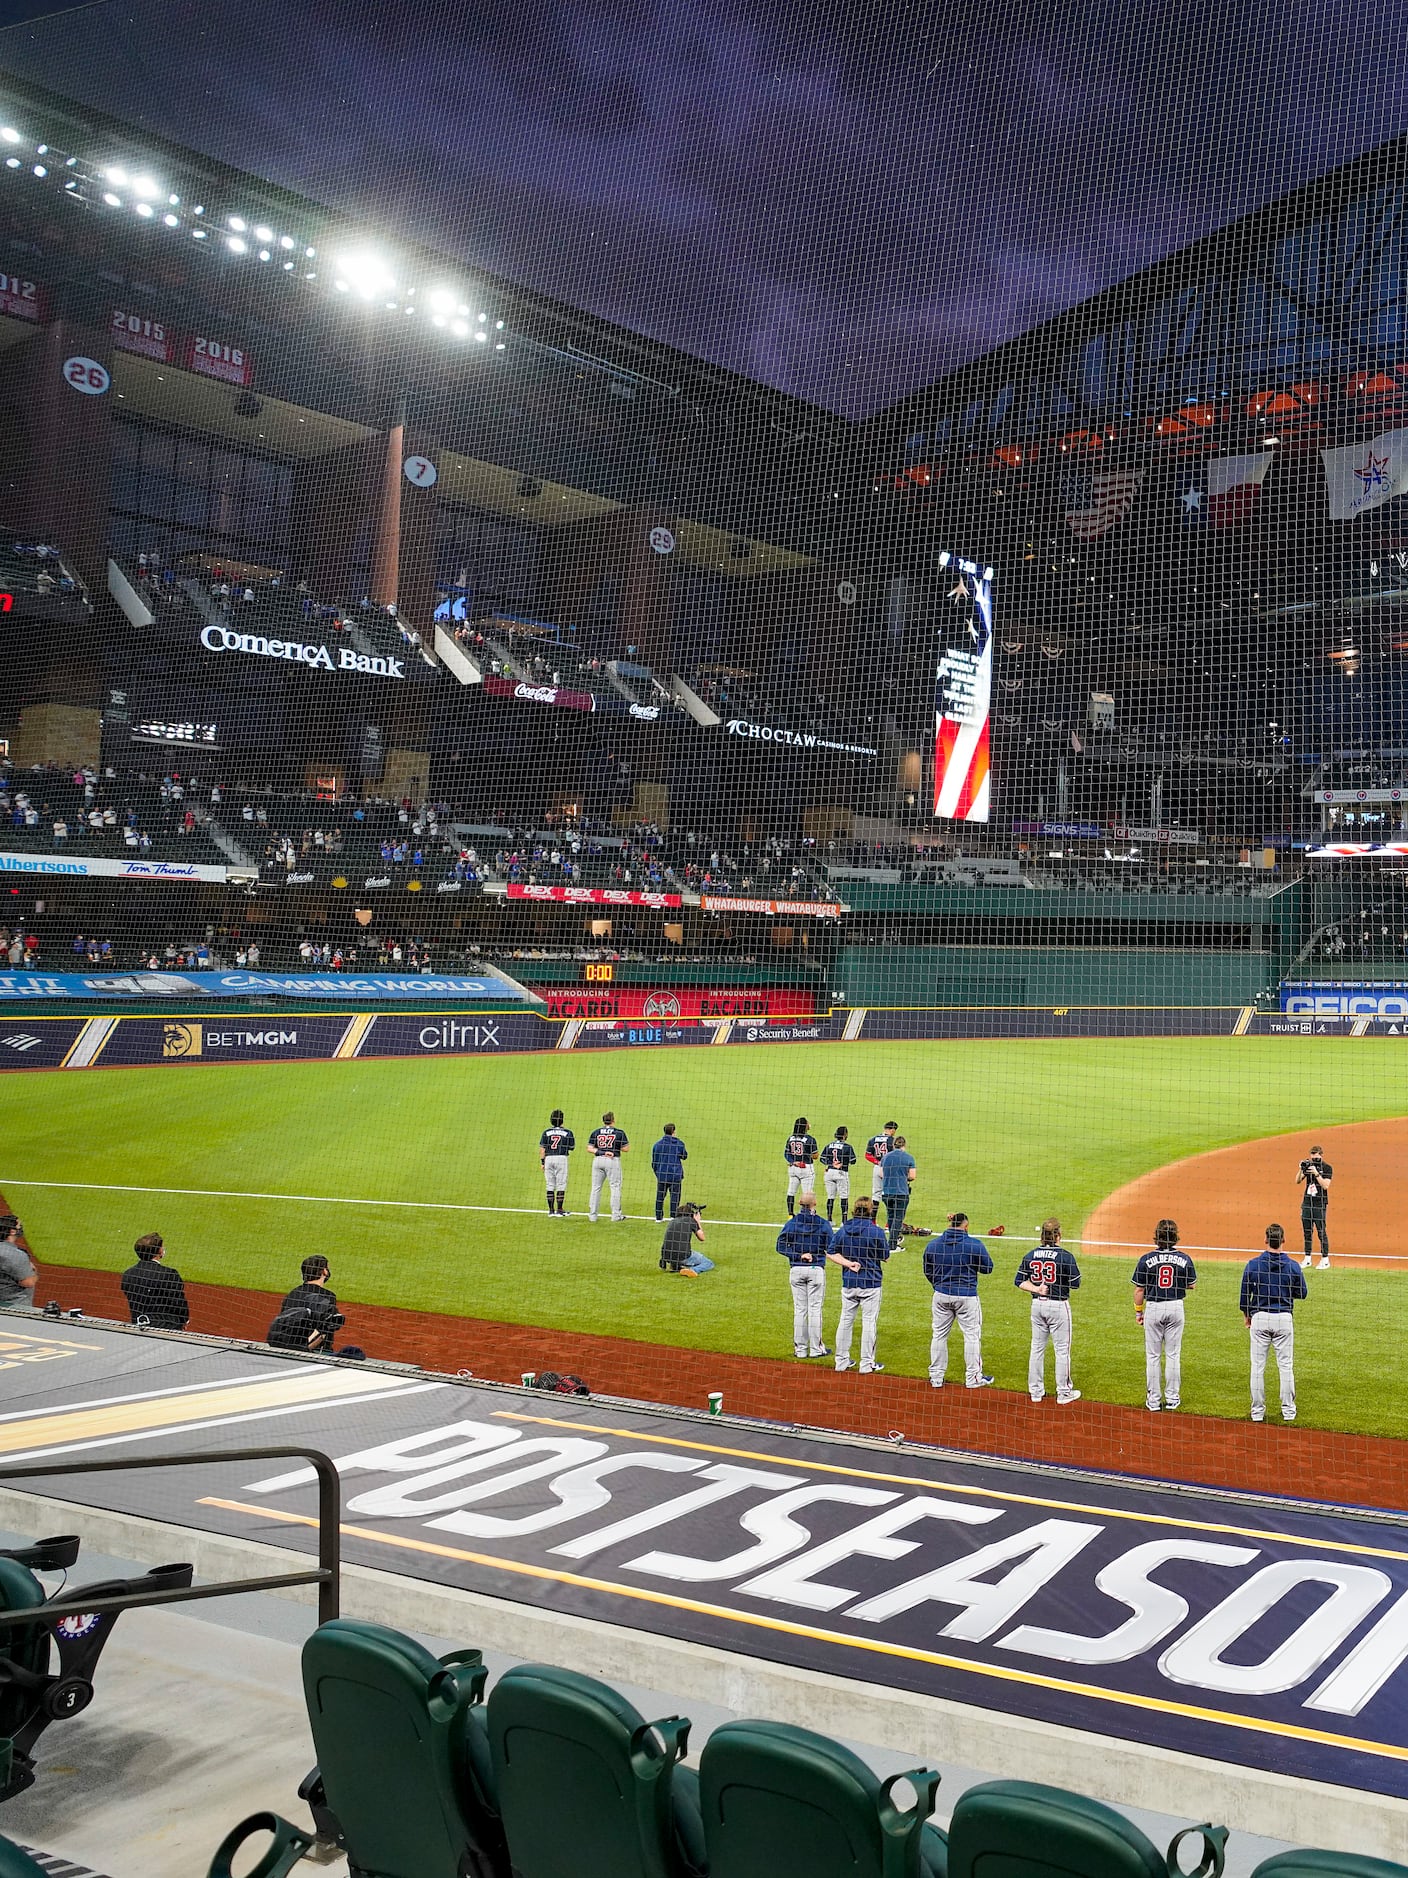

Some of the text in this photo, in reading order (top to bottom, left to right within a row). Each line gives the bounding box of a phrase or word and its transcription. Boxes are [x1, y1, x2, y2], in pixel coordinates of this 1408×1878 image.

[113, 310, 165, 340] 2015
[195, 337, 243, 366] 2016
[69, 362, 105, 388] 26
[415, 462, 427, 479] 7
[338, 648, 405, 679] Bank
[514, 683, 558, 703] Coca-Cola
[735, 720, 816, 748] CHOCTAW
[817, 739, 844, 751] CASINOS
[850, 746, 877, 755] RESORTS
[1043, 824, 1078, 835] SIGNS
[1129, 829, 1157, 841] QuikTrip
[121, 861, 151, 874] Tom
[151, 863, 199, 876] Thumb
[523, 885, 554, 895] DEX
[564, 888, 593, 897] DEX
[602, 890, 630, 900] DEX
[640, 892, 666, 901] DEX
[704, 897, 837, 915] WHATABURGER WHATABURGER
[586, 964, 613, 981] 0:00
[220, 975, 487, 991] CAMPING WORLD
[548, 996, 620, 1018] ACARDÍ
[1286, 996, 1408, 1022] GEICO
[419, 1019, 501, 1049] citrix
[629, 1029, 662, 1041] BLUE
[758, 1028, 819, 1039] Security Benefit
[1270, 1024, 1299, 1032] TRUIST
[207, 1030, 297, 1047] BETMGM
[550, 1135, 561, 1150] 7
[597, 1135, 616, 1148] 27
[790, 1142, 804, 1156] 13
[832, 1149, 838, 1162] 1
[874, 1142, 888, 1157] 14
[1033, 1250, 1058, 1260] MINTER
[1145, 1254, 1188, 1269] CULBERSON
[1030, 1261, 1057, 1283] 33
[1158, 1265, 1174, 1289] 8
[66, 1692, 76, 1708] 3
